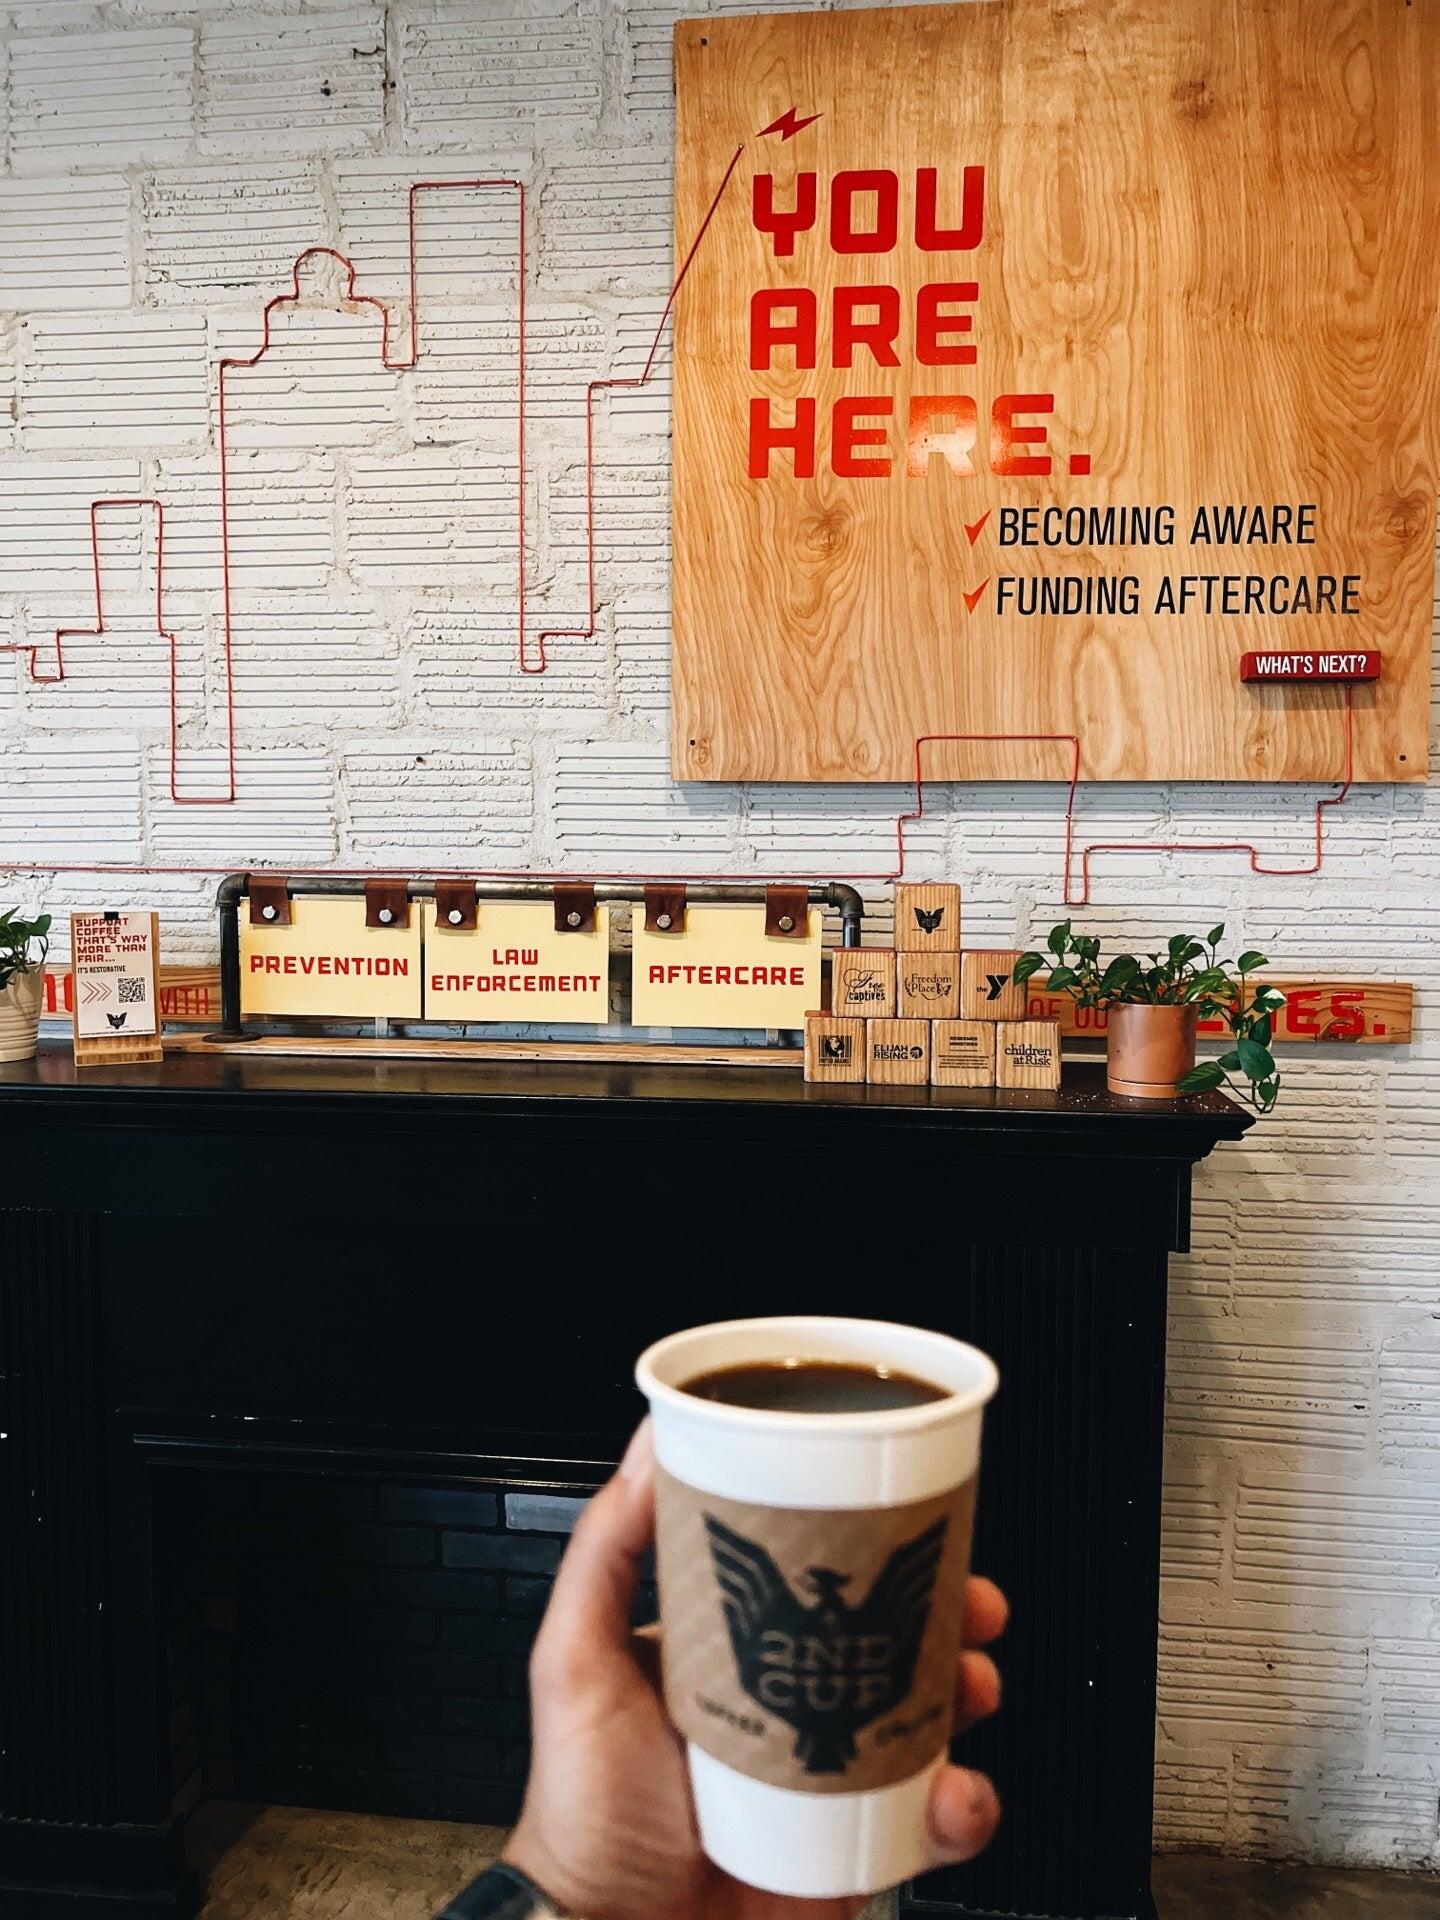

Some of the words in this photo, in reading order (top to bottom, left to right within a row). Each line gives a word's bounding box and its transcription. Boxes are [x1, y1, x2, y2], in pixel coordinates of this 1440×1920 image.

[753, 165, 985, 256] YOU
[750, 282, 979, 370] ARE
[748, 393, 1091, 478] HERE.
[1000, 506, 1175, 546] BECOMING
[1190, 505, 1317, 544] AWARE
[996, 576, 1139, 616] FUNDING
[1154, 575, 1361, 615] AFTERCARE
[1256, 656, 1313, 675] WHAT'S
[1318, 655, 1367, 674] NEXT?
[77, 927, 121, 936] COFFEE
[121, 934, 148, 943] WAY
[78, 945, 111, 954] MORE
[115, 944, 146, 952] THAN
[492, 949, 538, 965] LAW
[78, 954, 115, 963] FAIR...
[250, 955, 408, 976] PREVENTION
[89, 965, 126, 973] RESTORATIVE
[649, 965, 804, 985] AFTERCARE
[432, 975, 601, 992] ENFORCEMENT
[911, 973, 952, 983] Freedom
[849, 990, 886, 1002] captives
[911, 983, 935, 993] Place
[1004, 1043, 1052, 1056] children
